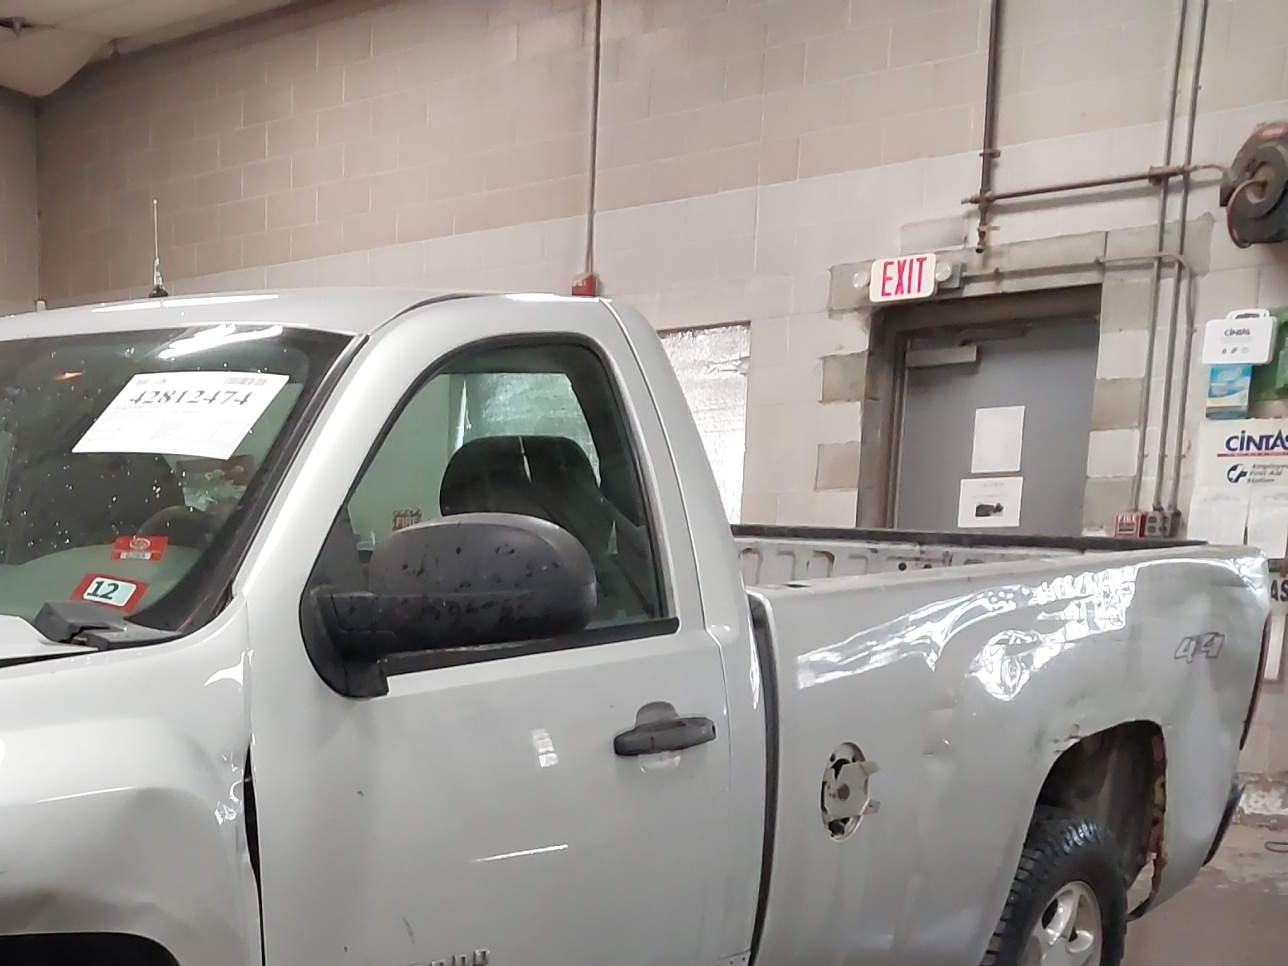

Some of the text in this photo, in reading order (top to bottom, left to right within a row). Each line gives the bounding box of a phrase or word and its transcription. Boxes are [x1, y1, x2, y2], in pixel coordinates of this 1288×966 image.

[881, 256, 928, 297] EXIT
[129, 389, 253, 406] 42812474
[86, 580, 120, 600] 12
